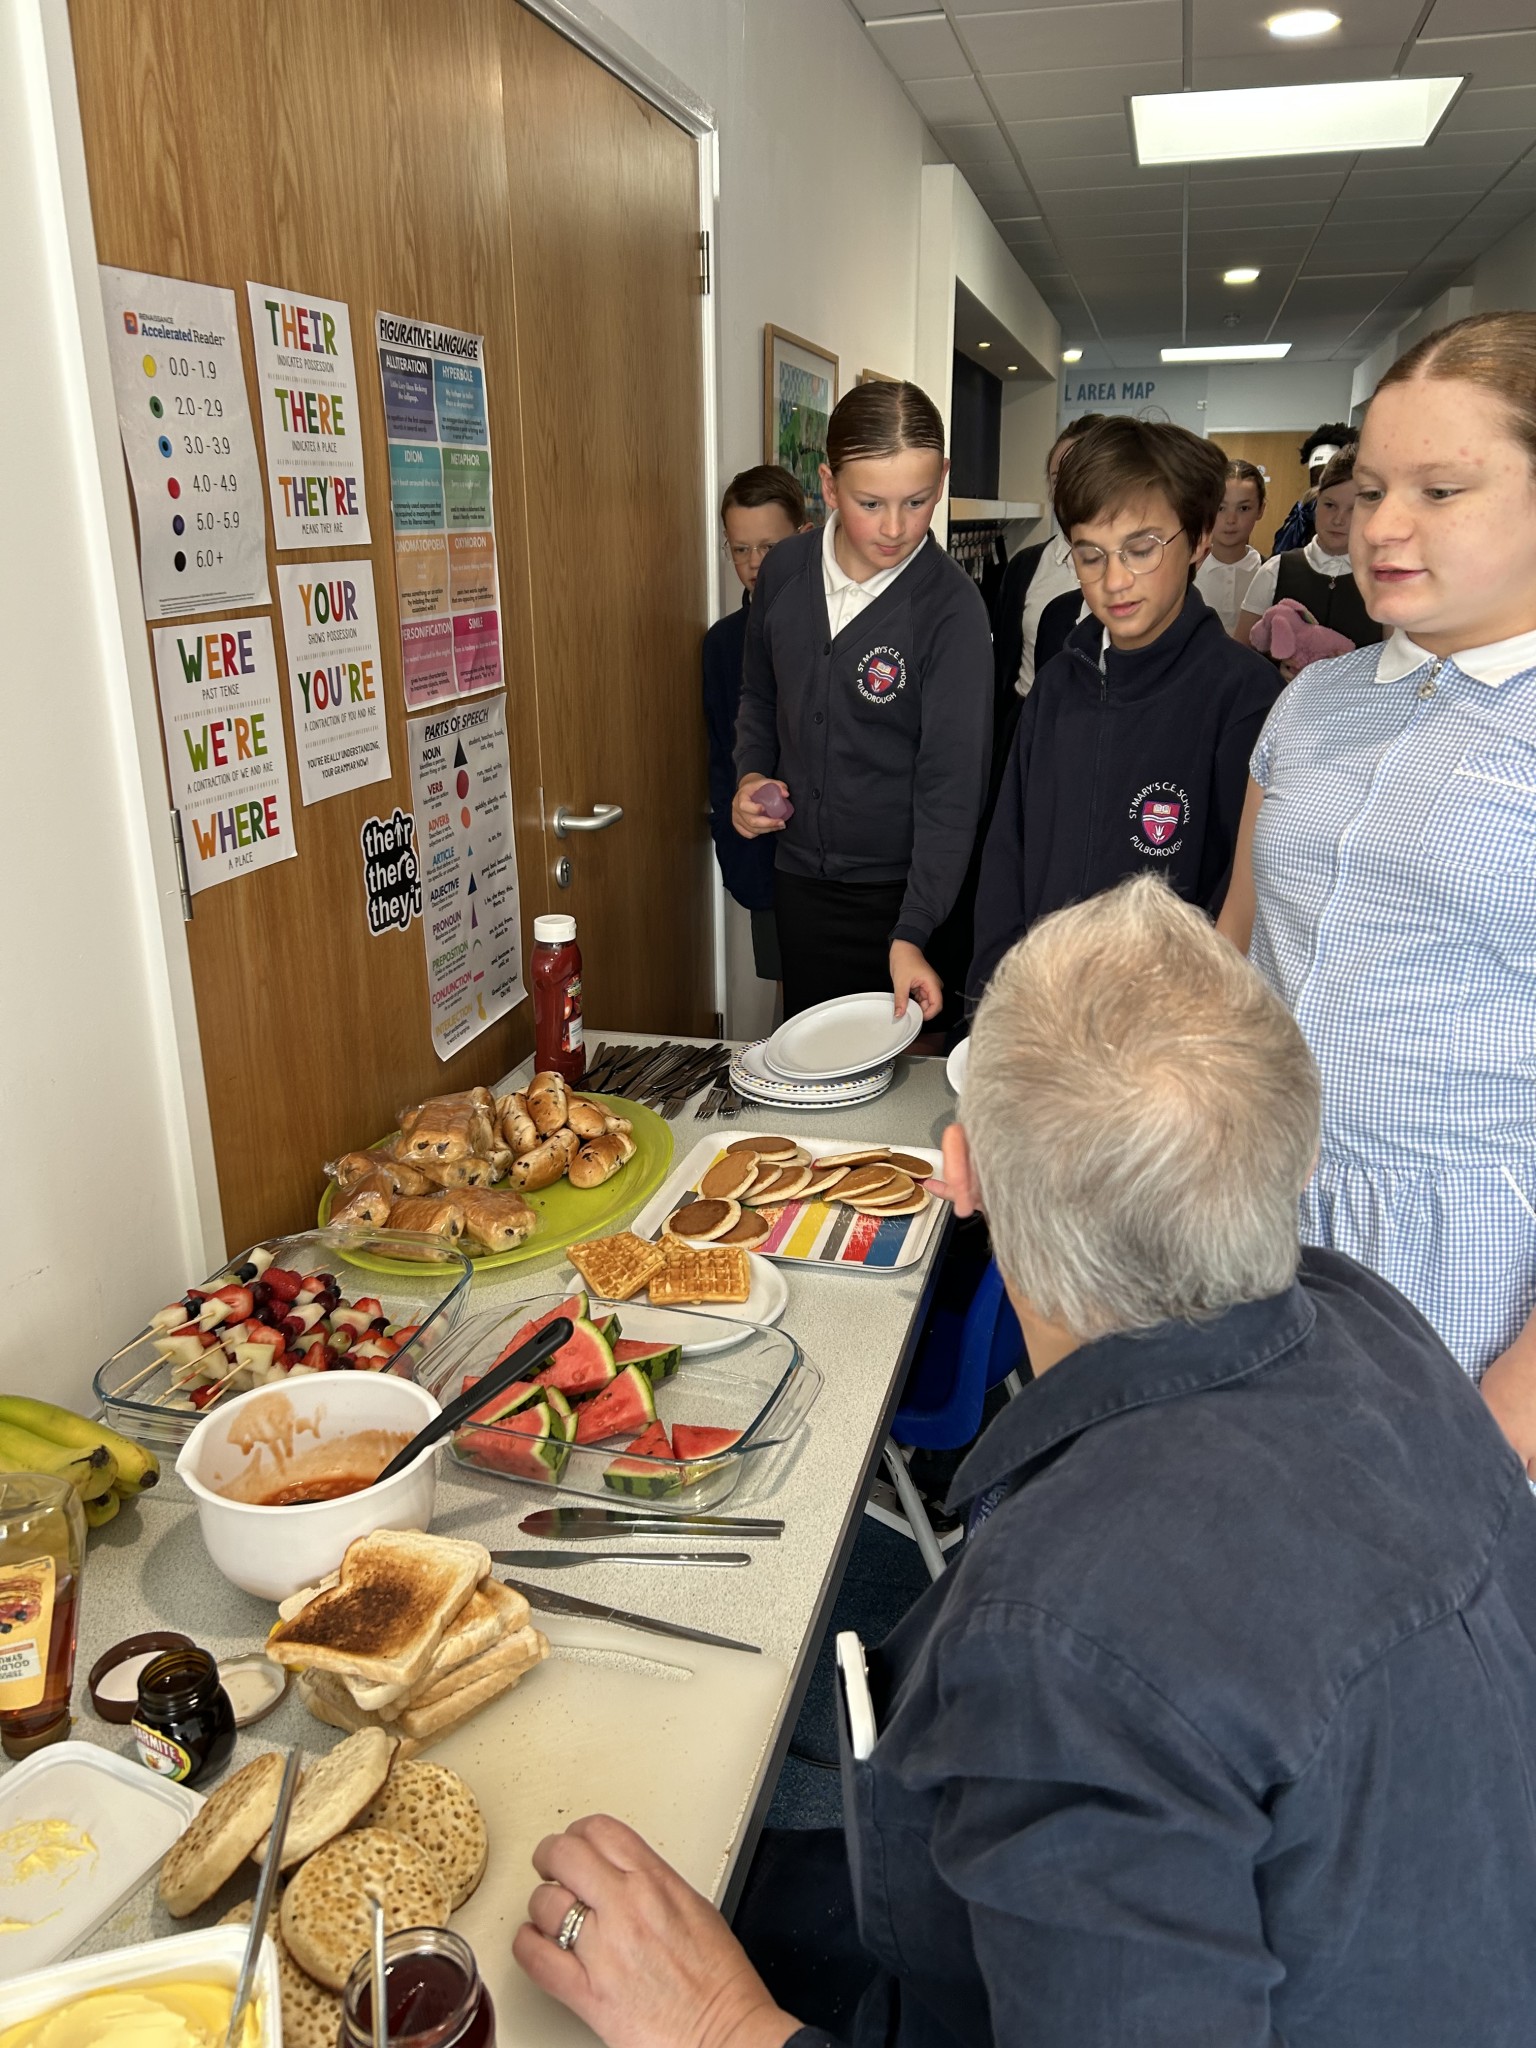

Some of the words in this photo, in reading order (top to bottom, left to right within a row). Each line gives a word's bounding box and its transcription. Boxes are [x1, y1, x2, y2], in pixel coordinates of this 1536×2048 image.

[139, 313, 175, 324] RENAISSANCE
[264, 299, 339, 356] THEIR
[141, 323, 193, 342] Accelerated
[380, 319, 432, 348] FIGURATIVE
[433, 331, 478, 358] LANGUAGE
[277, 354, 302, 369] INDICATES
[304, 358, 334, 373] POSSESSION
[386, 355, 428, 375] ALLITERATION
[442, 365, 473, 382] HYPERBOLE
[1077, 383, 1116, 401] AREA
[1122, 382, 1155, 400] MAP
[274, 388, 346, 437] THERE
[292, 440, 315, 452] INDICATES
[322, 442, 338, 453] PLACE
[405, 450, 424, 463] IDIOM
[450, 454, 480, 466] METAPHOR
[278, 475, 359, 517] THEY'RE
[302, 523, 319, 535] MEANS
[319, 522, 332, 534] THEY
[333, 522, 344, 533] ARE
[454, 536, 487, 549] OXYMORON
[298, 581, 359, 627] YOUR
[469, 617, 483, 630] SIMILE
[308, 632, 326, 645] SHOWS
[326, 627, 357, 642] POSSESSION
[176, 630, 255, 683] WERE
[857, 662, 865, 673] ST
[897, 658, 907, 689] SCHOOL
[202, 687, 217, 700] PAST
[219, 684, 240, 696] TENSE
[297, 659, 375, 714] YOU'RE
[857, 679, 897, 704] PULBOROUGH
[304, 722, 308, 733] A
[309, 715, 340, 731] CONTRACTION
[341, 712, 347, 723] OF
[348, 711, 357, 721] YOU
[357, 708, 367, 719] AND
[367, 706, 376, 716] ARE
[424, 719, 449, 740] PARTS
[451, 716, 461, 731] OF
[462, 706, 489, 728] SPEECH
[183, 713, 268, 773] WE'RE
[422, 745, 441, 762] NOUN
[307, 756, 324, 769] YOU'RE
[324, 752, 340, 765] REALLY
[322, 767, 334, 779] YOUR
[334, 761, 357, 775] GRAMMAR
[187, 783, 192, 794] A
[193, 774, 231, 793] CONTRACTION
[231, 770, 239, 781] OF
[240, 768, 249, 779] WE
[250, 764, 261, 777] AND
[263, 761, 273, 773] ARE
[427, 781, 443, 795] VERB
[1131, 782, 1160, 807] MARY'S
[1129, 808, 1137, 819] ST
[1177, 789, 1191, 825] SCHOOL
[191, 795, 280, 861] WHERE
[428, 813, 450, 832] ADVERB
[432, 846, 455, 866] ARTICLE
[1130, 835, 1183, 857] PULBOROUGH
[228, 859, 234, 870] A
[235, 851, 253, 865] PLACE
[430, 877, 460, 902] ADJECTIVE
[432, 910, 462, 935] PRONOUN
[432, 940, 469, 971] PREPOSITION
[432, 970, 472, 1005] CONJUNCTION
[435, 1002, 473, 1037] INTERJECTION
